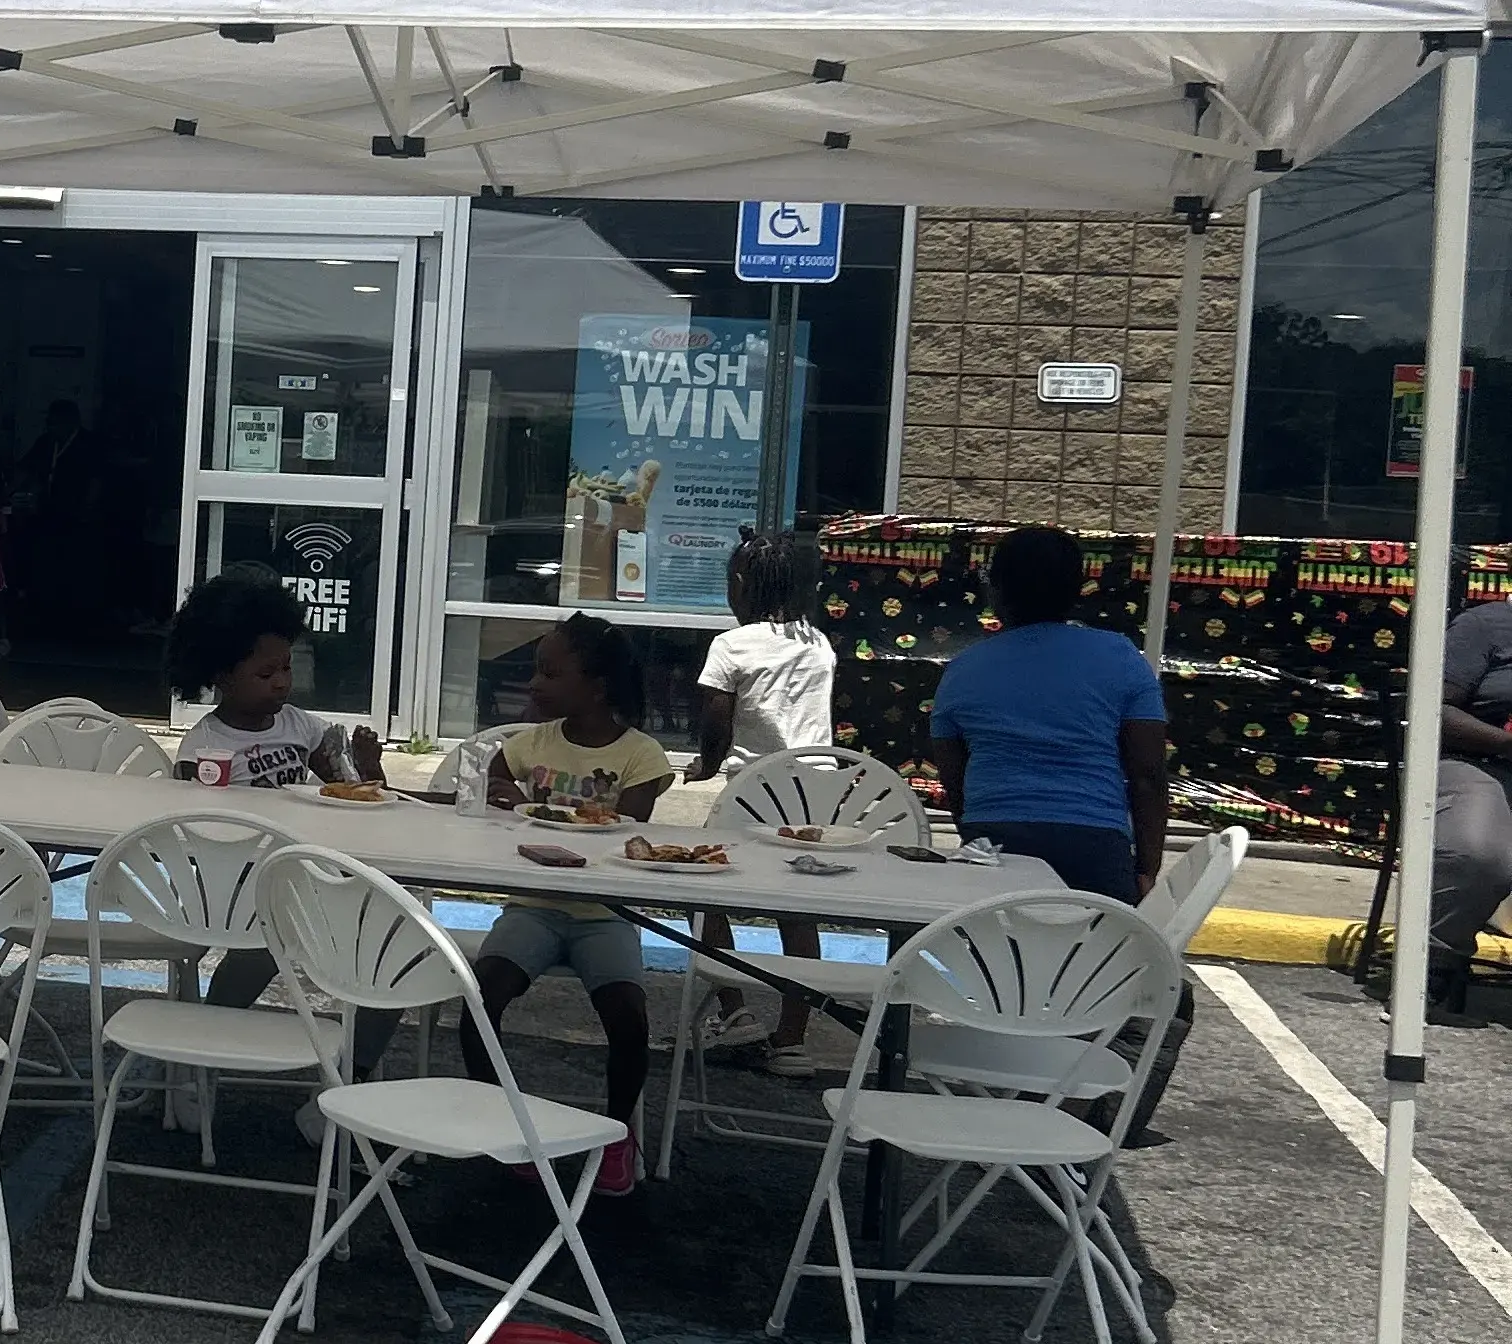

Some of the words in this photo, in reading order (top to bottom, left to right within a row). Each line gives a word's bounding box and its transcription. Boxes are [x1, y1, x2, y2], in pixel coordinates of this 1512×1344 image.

[620, 350, 748, 387] WASH
[620, 385, 763, 441] WIN
[674, 484, 713, 496] tarjeta
[715, 486, 730, 496] de
[733, 488, 759, 499] rega
[676, 497, 691, 506] de
[1297, 563, 1416, 597] NETEENTH
